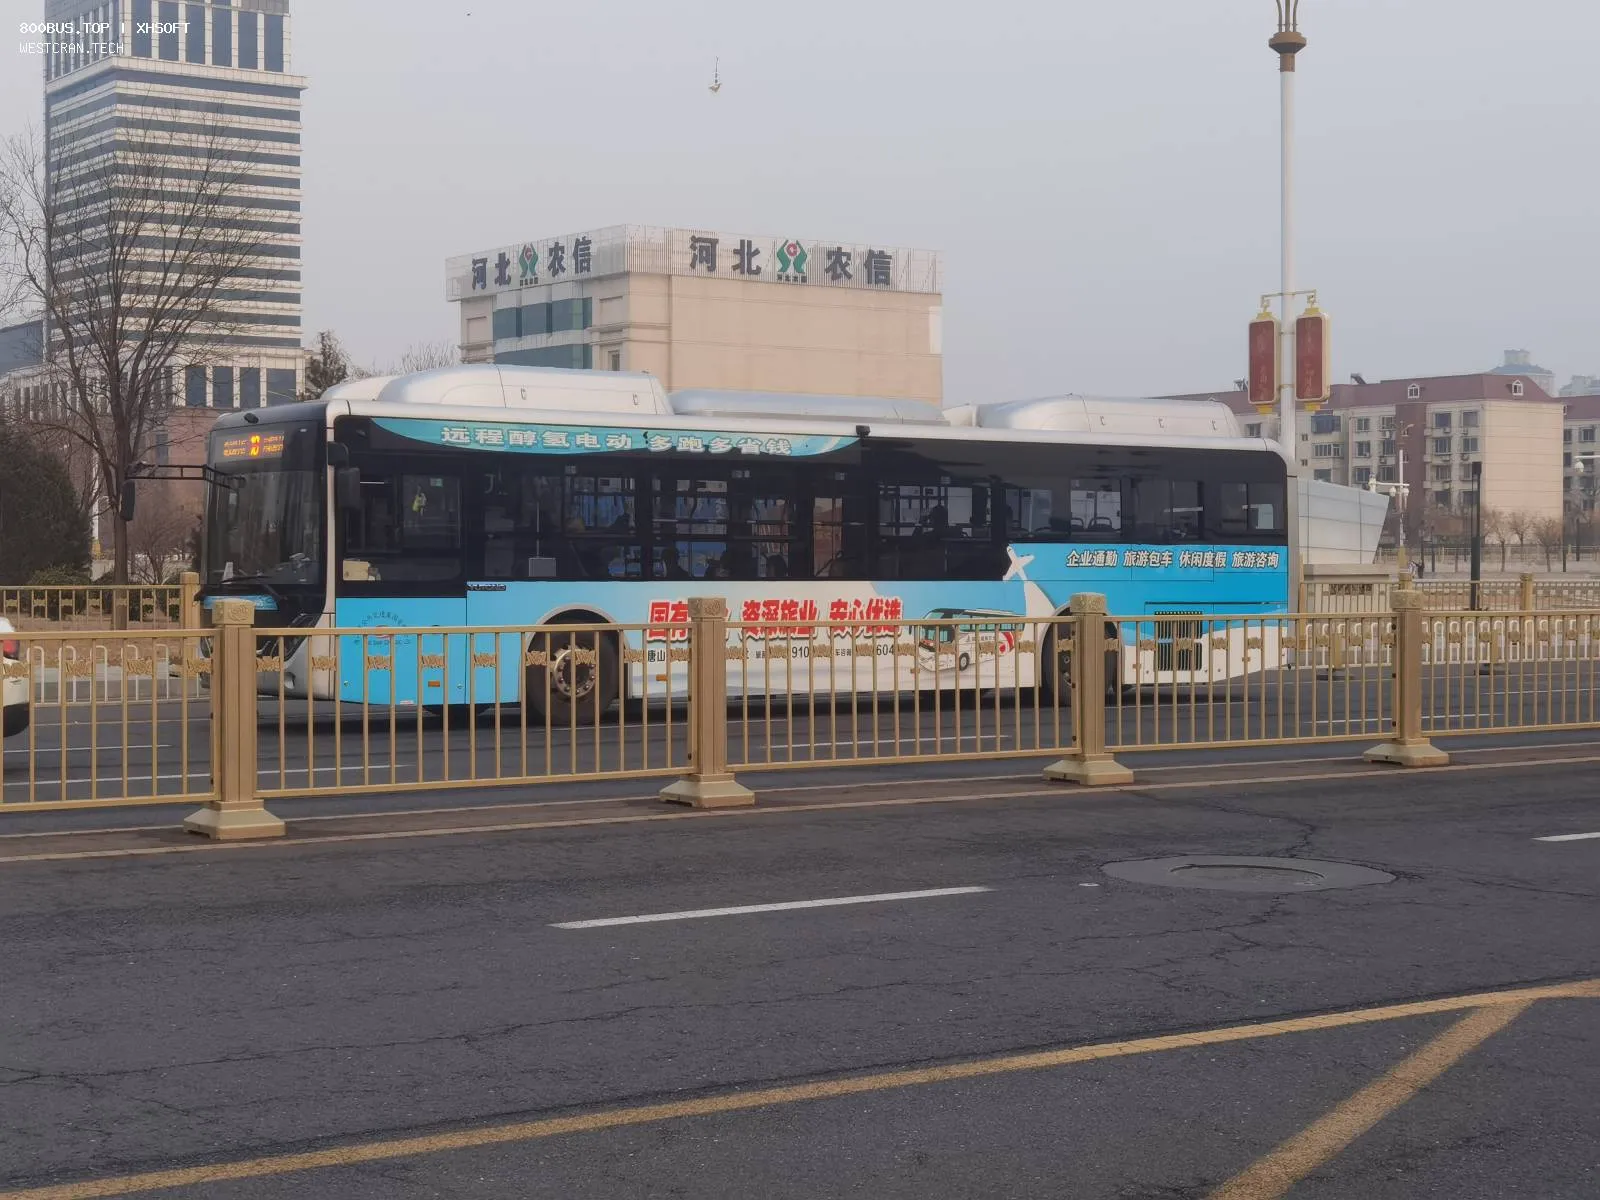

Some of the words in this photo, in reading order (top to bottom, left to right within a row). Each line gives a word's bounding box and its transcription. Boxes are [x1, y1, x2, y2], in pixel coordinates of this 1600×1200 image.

[471, 252, 512, 291] 河北
[547, 236, 593, 278] 农信
[689, 235, 762, 276] 河北
[824, 246, 893, 286] 农信
[440, 425, 632, 450] 远程醇氢电动
[649, 435, 792, 456] 多跑多省钱
[1066, 550, 1118, 567] 企业通勤
[1123, 551, 1173, 567] 旅游包车
[1179, 551, 1227, 568] 休闲度假
[1231, 552, 1279, 569] 旅游咨询
